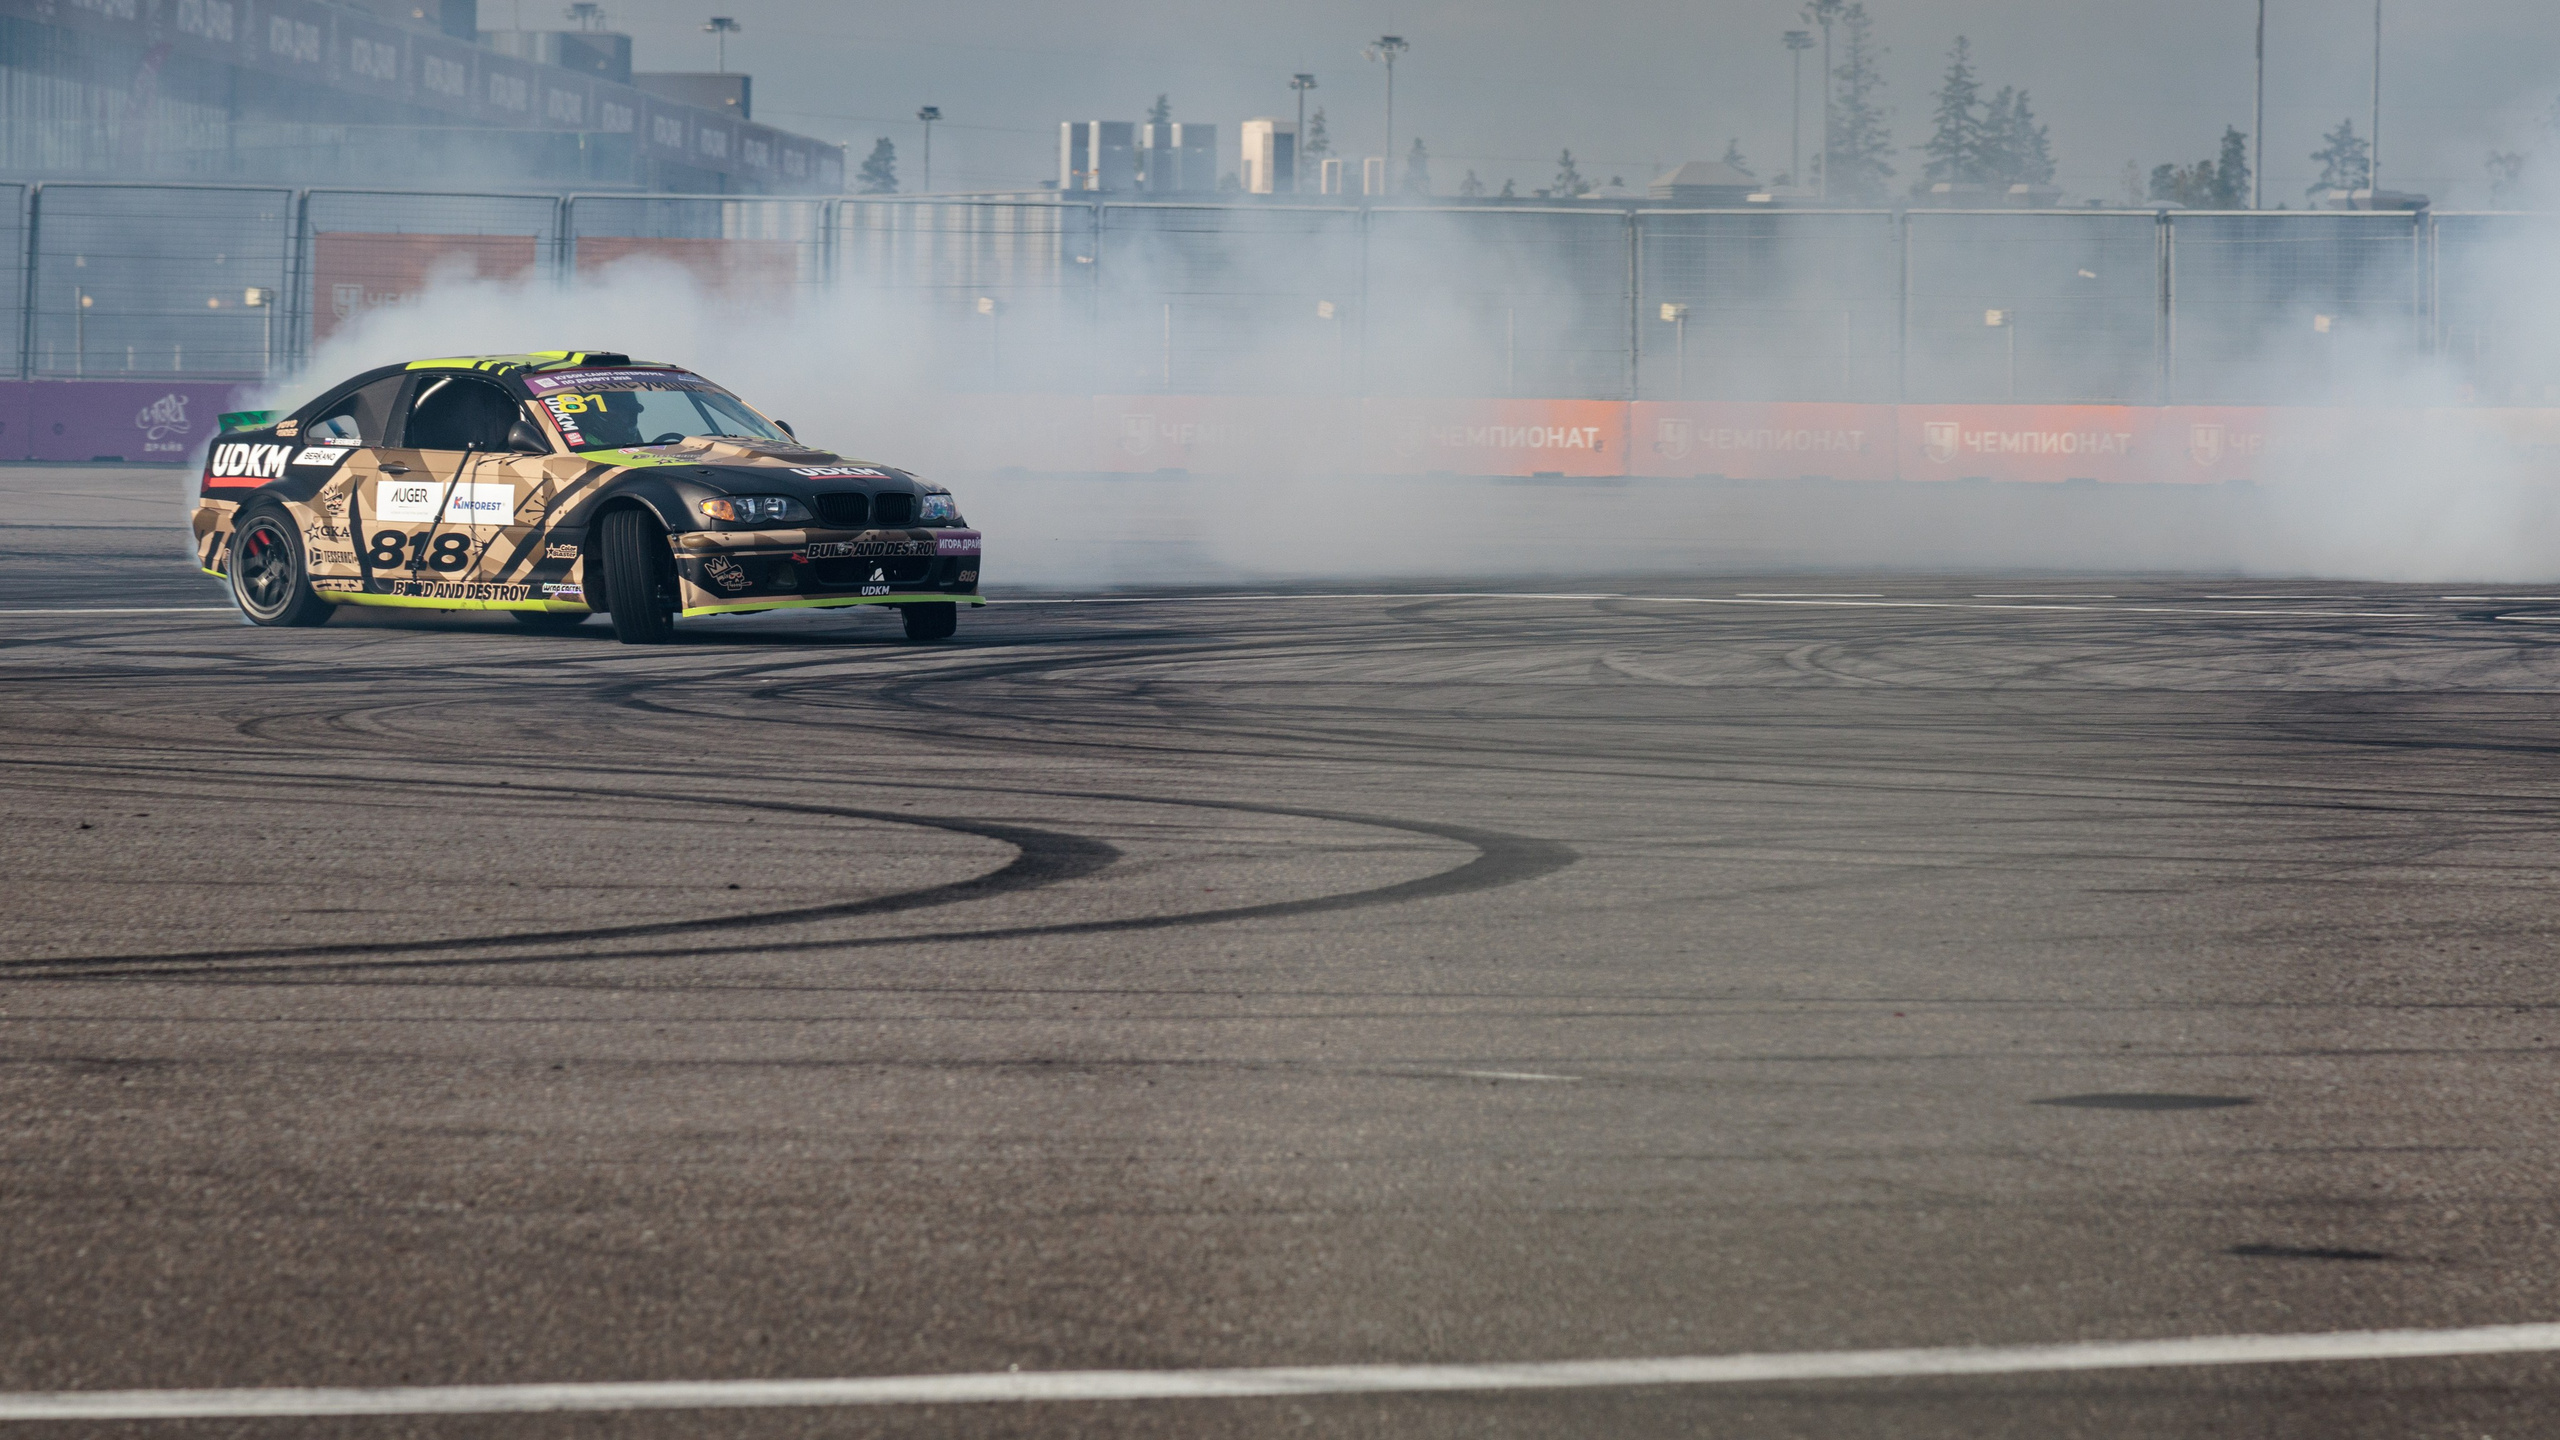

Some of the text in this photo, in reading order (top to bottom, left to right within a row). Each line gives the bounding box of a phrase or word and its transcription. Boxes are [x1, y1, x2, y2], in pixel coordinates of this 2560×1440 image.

[554, 373, 584, 381] КУБОК
[576, 376, 610, 384] ДРИФТУ
[556, 393, 608, 414] 81
[544, 397, 579, 432] UDKM
[1430, 424, 1600, 449] ЧЕМПИОНАТ
[1698, 427, 1865, 452] ЧЕМПИОНАТ
[1964, 431, 2131, 455] ЧЕМПИОНАТ
[212, 444, 293, 478] UDKM
[789, 468, 886, 477] UDKM
[391, 488, 428, 503] AUGER
[453, 496, 502, 511] KINFOREST
[320, 525, 350, 537] GKA
[853, 541, 886, 557] AND
[939, 538, 962, 549] ИГОРА
[368, 530, 472, 573] 818
[958, 569, 977, 582] 818
[434, 583, 465, 599] AND
[466, 584, 528, 601] DESTROY
[861, 585, 890, 596] UDKM
